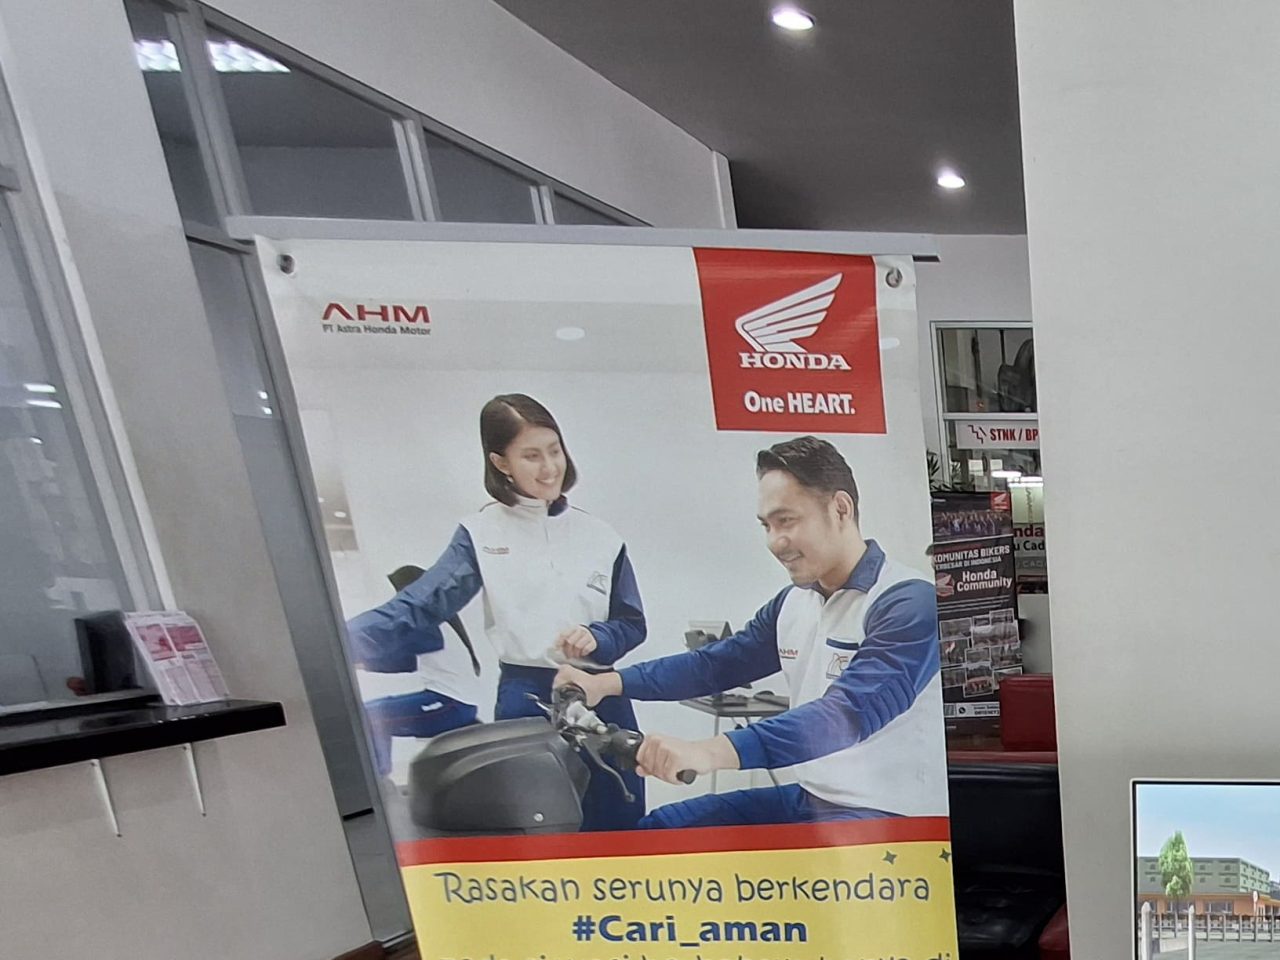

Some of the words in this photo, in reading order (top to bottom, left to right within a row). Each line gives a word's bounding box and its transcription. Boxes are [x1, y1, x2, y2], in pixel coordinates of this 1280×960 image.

[322, 303, 431, 323] AHM
[337, 325, 362, 334] Astra
[364, 325, 397, 334] Honda
[400, 326, 431, 335] Motor
[739, 352, 851, 370] HONDA
[744, 391, 784, 413] One
[787, 392, 855, 414] HEART.
[990, 428, 1016, 441] STNK
[980, 545, 1010, 557] BIKERS
[962, 568, 998, 582] Honda
[957, 577, 1013, 592] Community
[433, 871, 580, 904] Rasakan
[593, 875, 724, 904] serunya
[735, 873, 931, 902] berkendara
[572, 914, 808, 947] #Cari_aman
